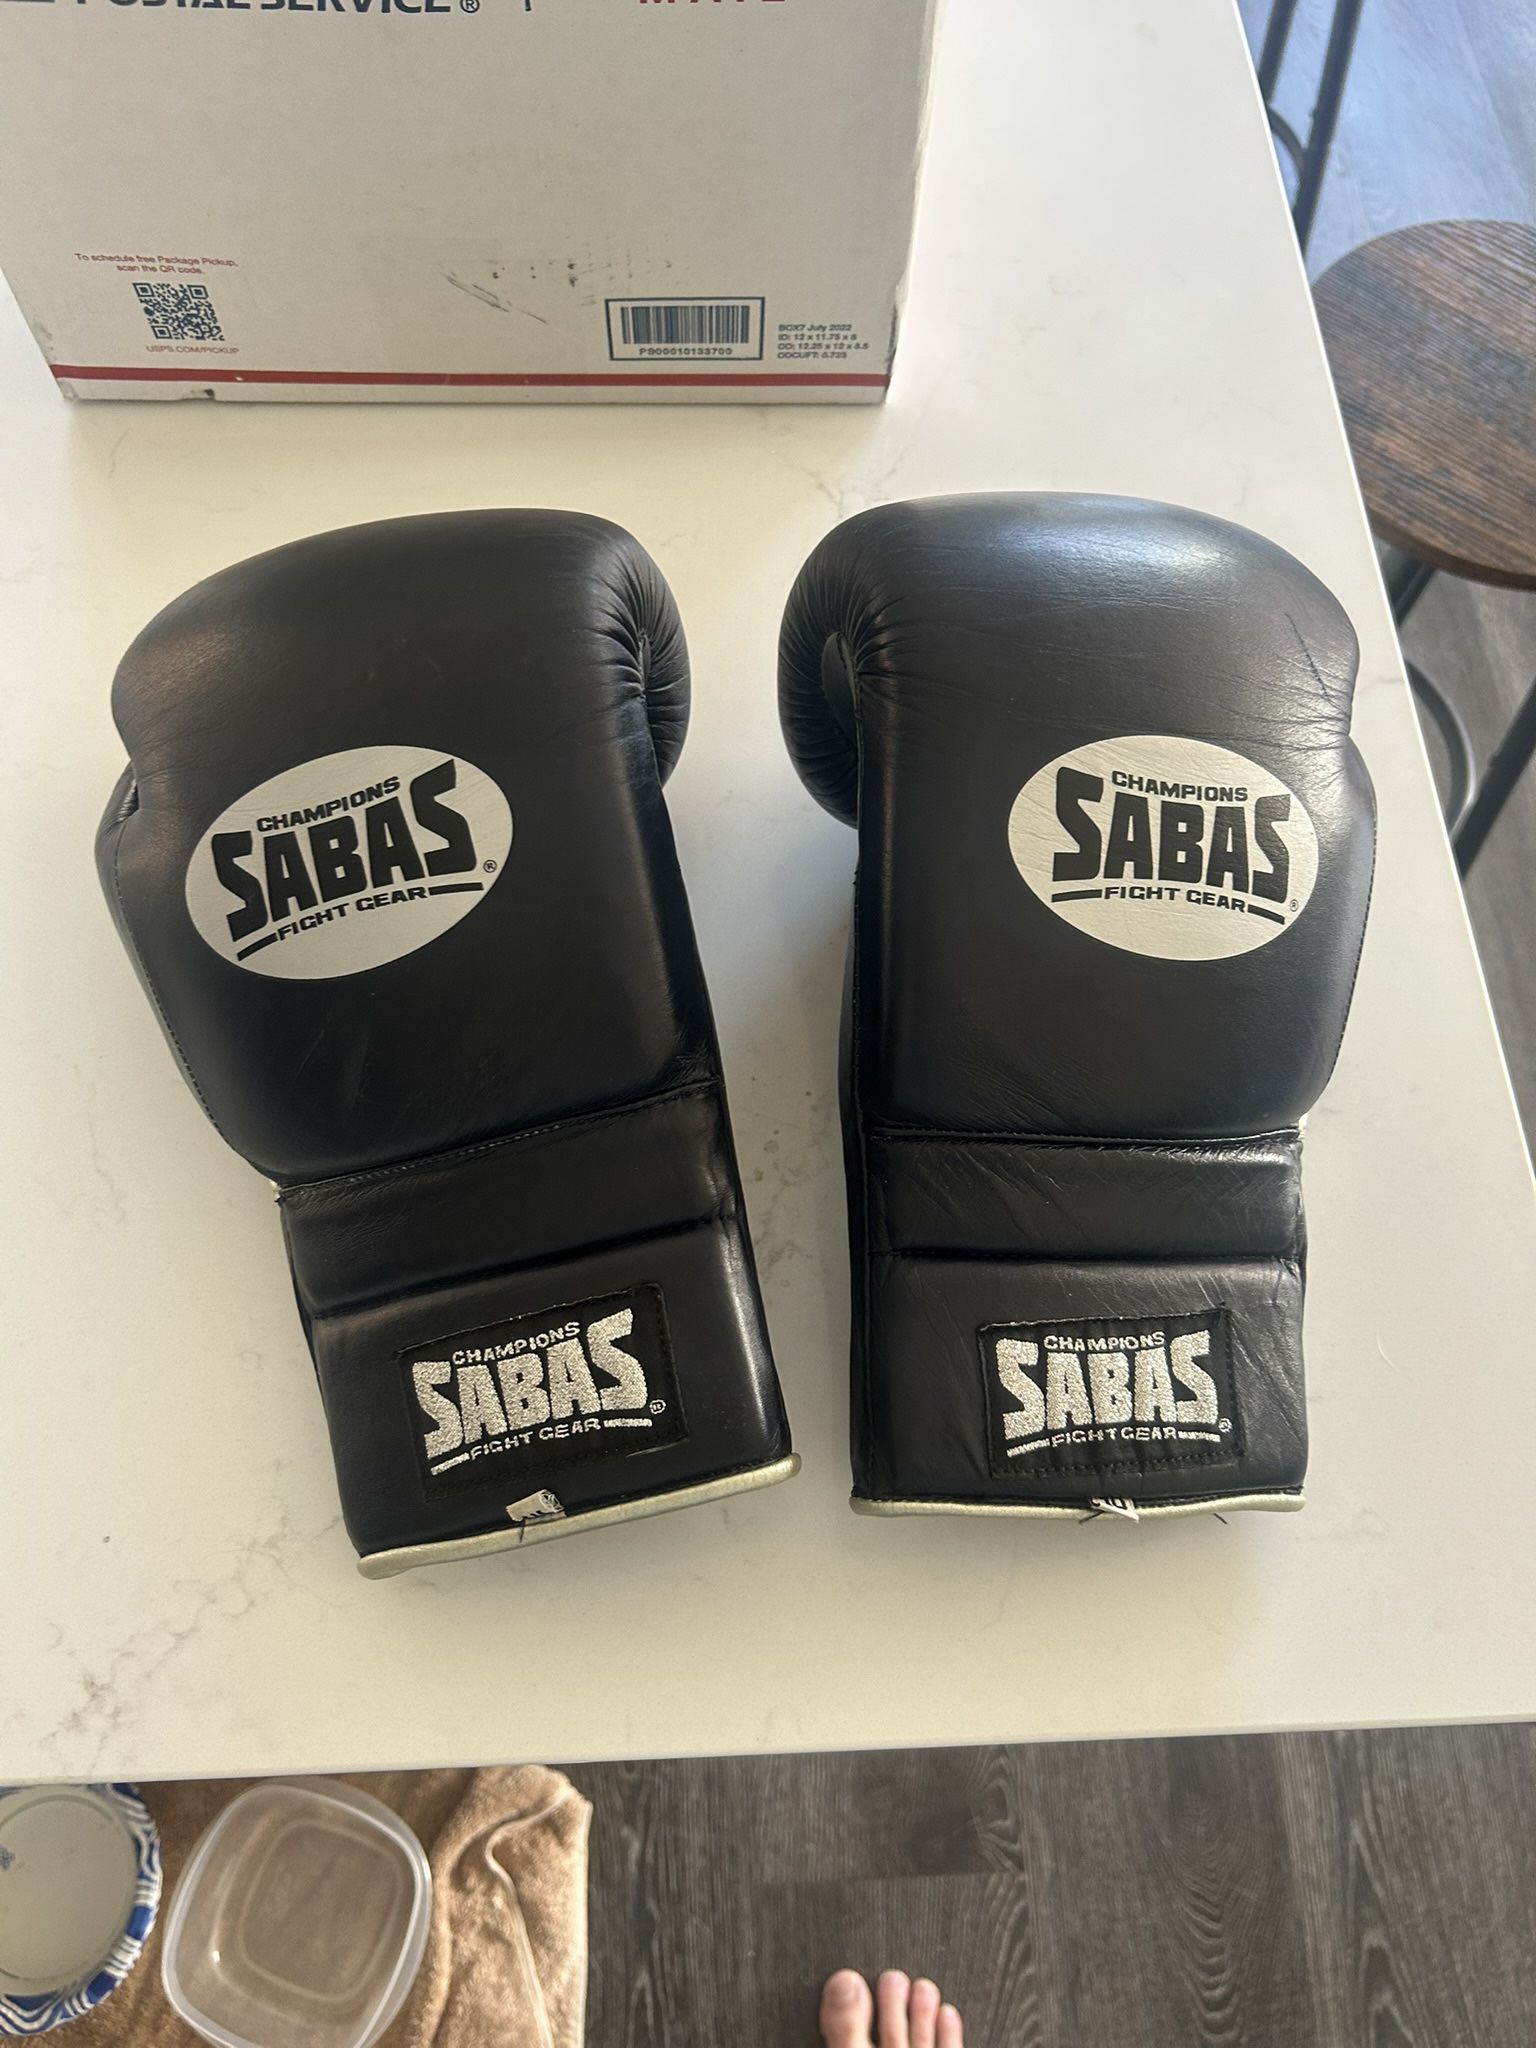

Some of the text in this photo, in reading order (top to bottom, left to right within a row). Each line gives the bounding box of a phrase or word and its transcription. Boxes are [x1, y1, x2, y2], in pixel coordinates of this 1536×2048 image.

[75, 253, 87, 262] To
[92, 254, 135, 263] schedule
[136, 255, 156, 263] free
[158, 256, 200, 267] Package
[117, 264, 140, 272] scan
[142, 264, 158, 272] the
[159, 265, 177, 274] QR
[807, 324, 828, 333] July
[256, 776, 401, 833] CHAMPIONS
[1111, 770, 1248, 802] CHAMPIONS
[211, 758, 477, 942] SABAS
[1052, 766, 1292, 904] SABAS
[277, 886, 428, 941] FIGHT GEAR
[1104, 886, 1247, 913] FIGHT GEAR
[453, 1321, 581, 1365] CHAMPIONS
[1043, 1331, 1166, 1351] CHAMPIONS
[412, 1308, 648, 1460] SABAS
[995, 1329, 1219, 1440] SABAS
[469, 1418, 601, 1461] FIGHT GEAR
[1051, 1426, 1179, 1448] FIGHT GEAR
